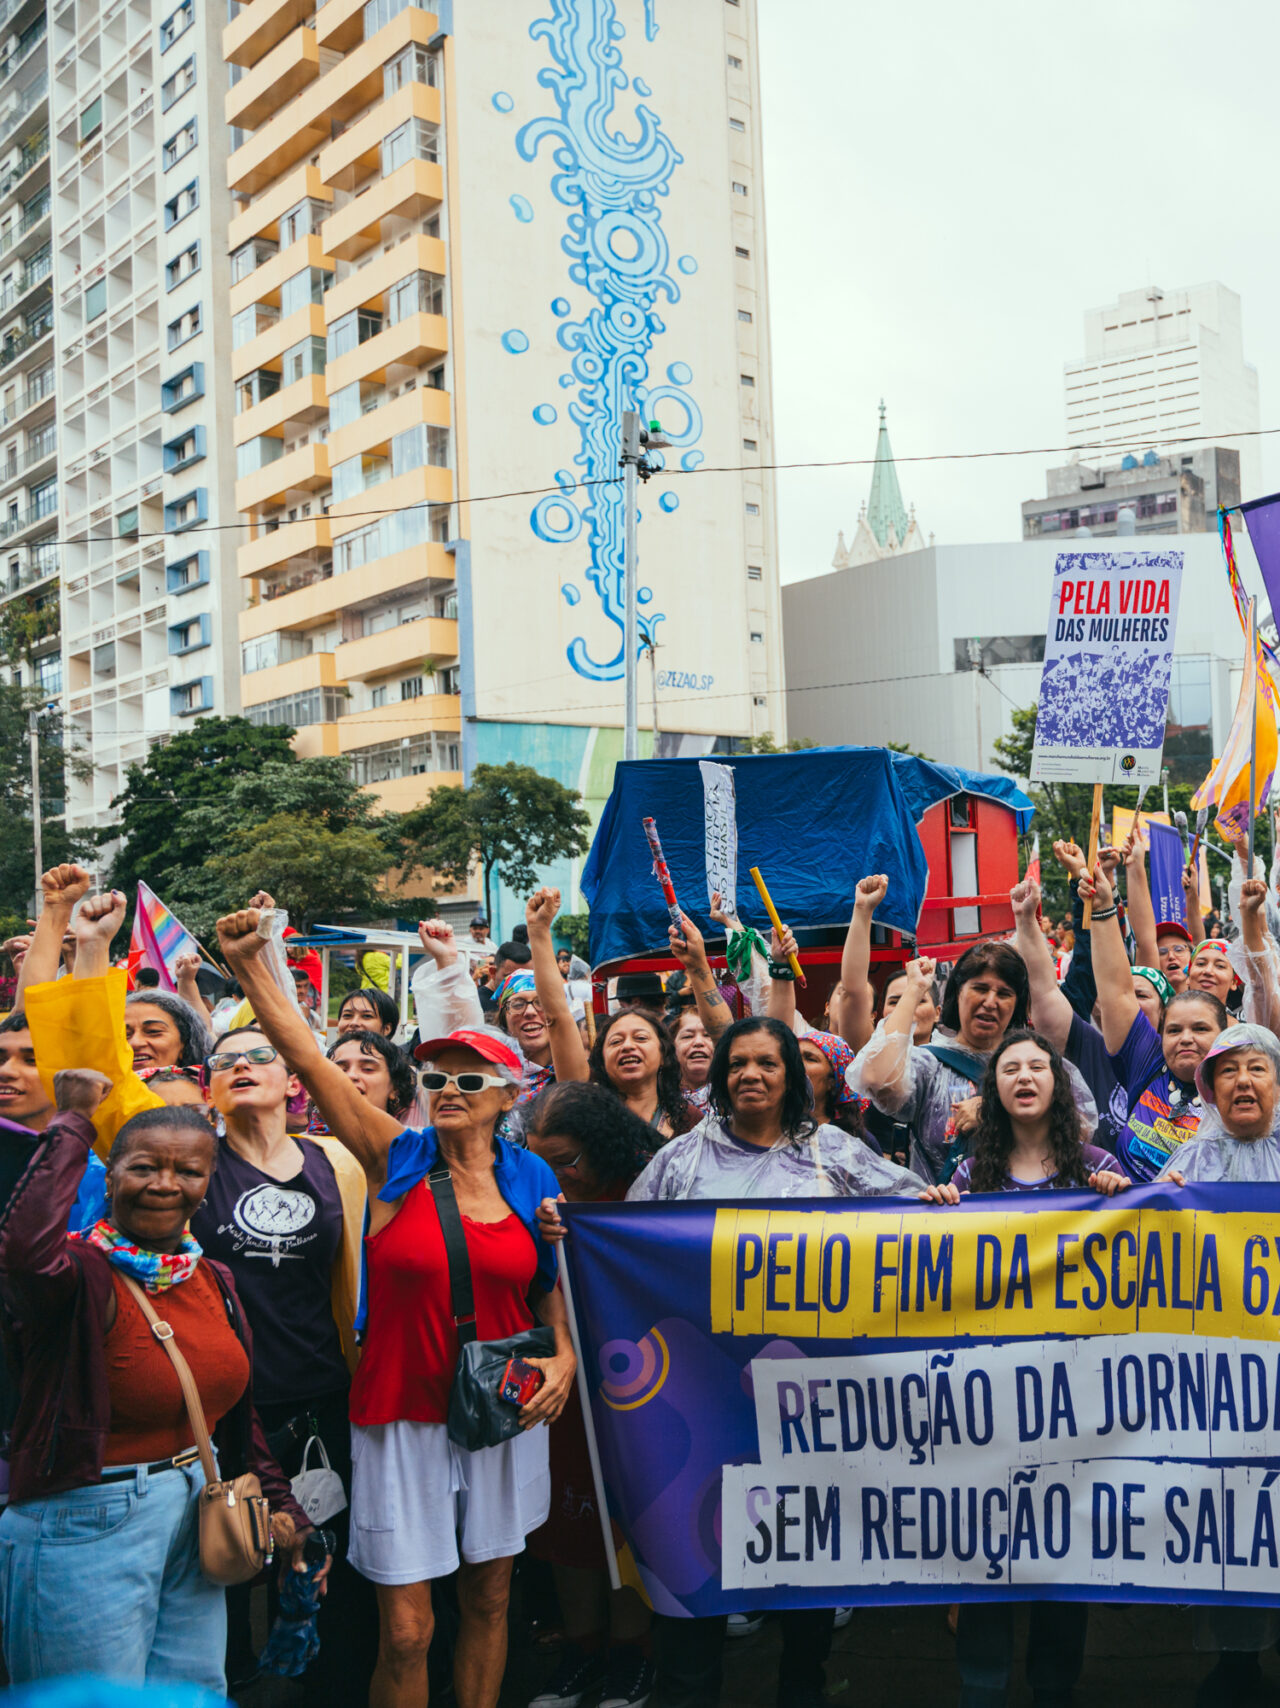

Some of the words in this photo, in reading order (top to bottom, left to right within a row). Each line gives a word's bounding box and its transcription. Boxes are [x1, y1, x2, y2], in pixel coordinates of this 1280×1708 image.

[1055, 618, 1085, 642] DAS
[1088, 616, 1169, 642] MULHERES
[1058, 580, 1111, 615] PELA
[1118, 579, 1170, 615] VIDA
[719, 805, 728, 869] BRASIL
[735, 1232, 851, 1314] PELO
[872, 1232, 955, 1314] FIM
[974, 1233, 1034, 1311] DA
[1055, 1230, 1223, 1312] ESCALA
[776, 1352, 994, 1466] REDUÇÃO
[1014, 1360, 1078, 1443] DA
[746, 1485, 841, 1565] SEM
[861, 1469, 1071, 1580] REDUÇÃO
[1091, 1482, 1146, 1560] DE
